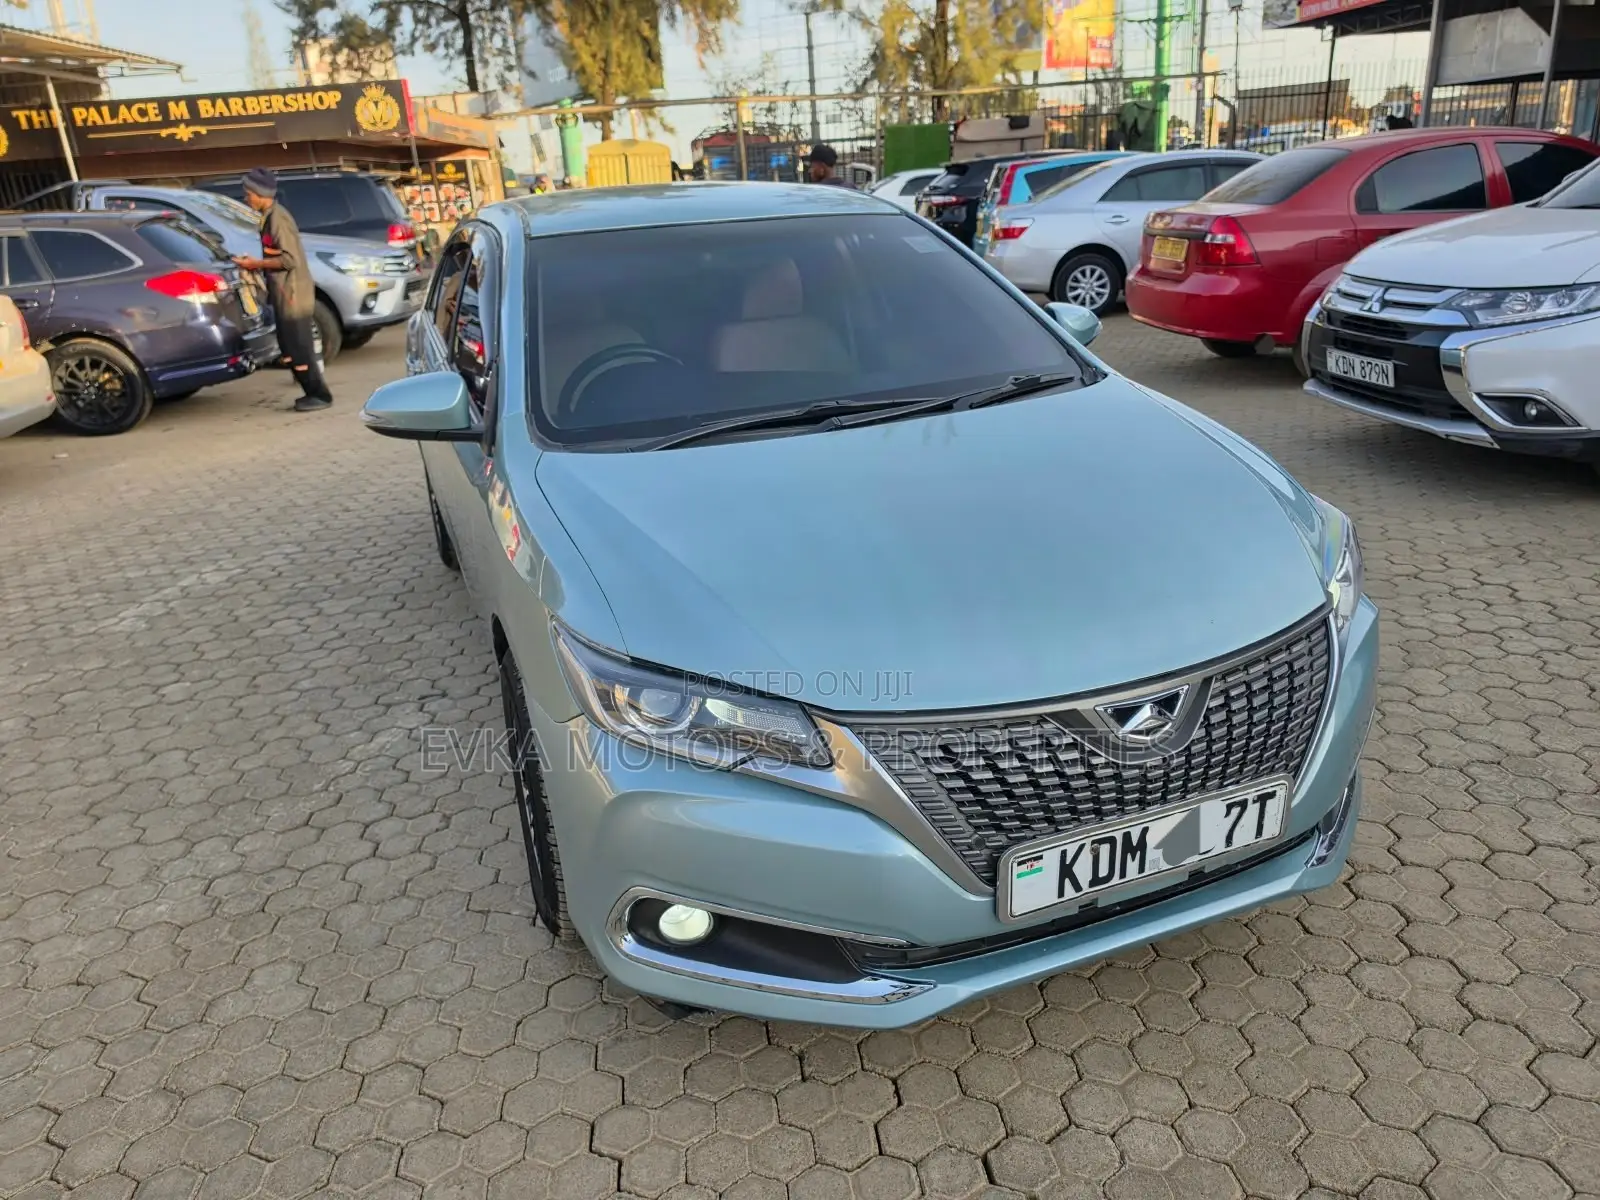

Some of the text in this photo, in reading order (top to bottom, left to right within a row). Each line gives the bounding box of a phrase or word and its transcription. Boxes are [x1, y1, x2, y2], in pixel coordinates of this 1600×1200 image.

[72, 102, 162, 127] PALACE
[168, 100, 190, 120] M
[197, 91, 341, 118] BARBERSHOP
[1335, 355, 1389, 384] KDN 879N
[1057, 826, 1150, 899] KDM
